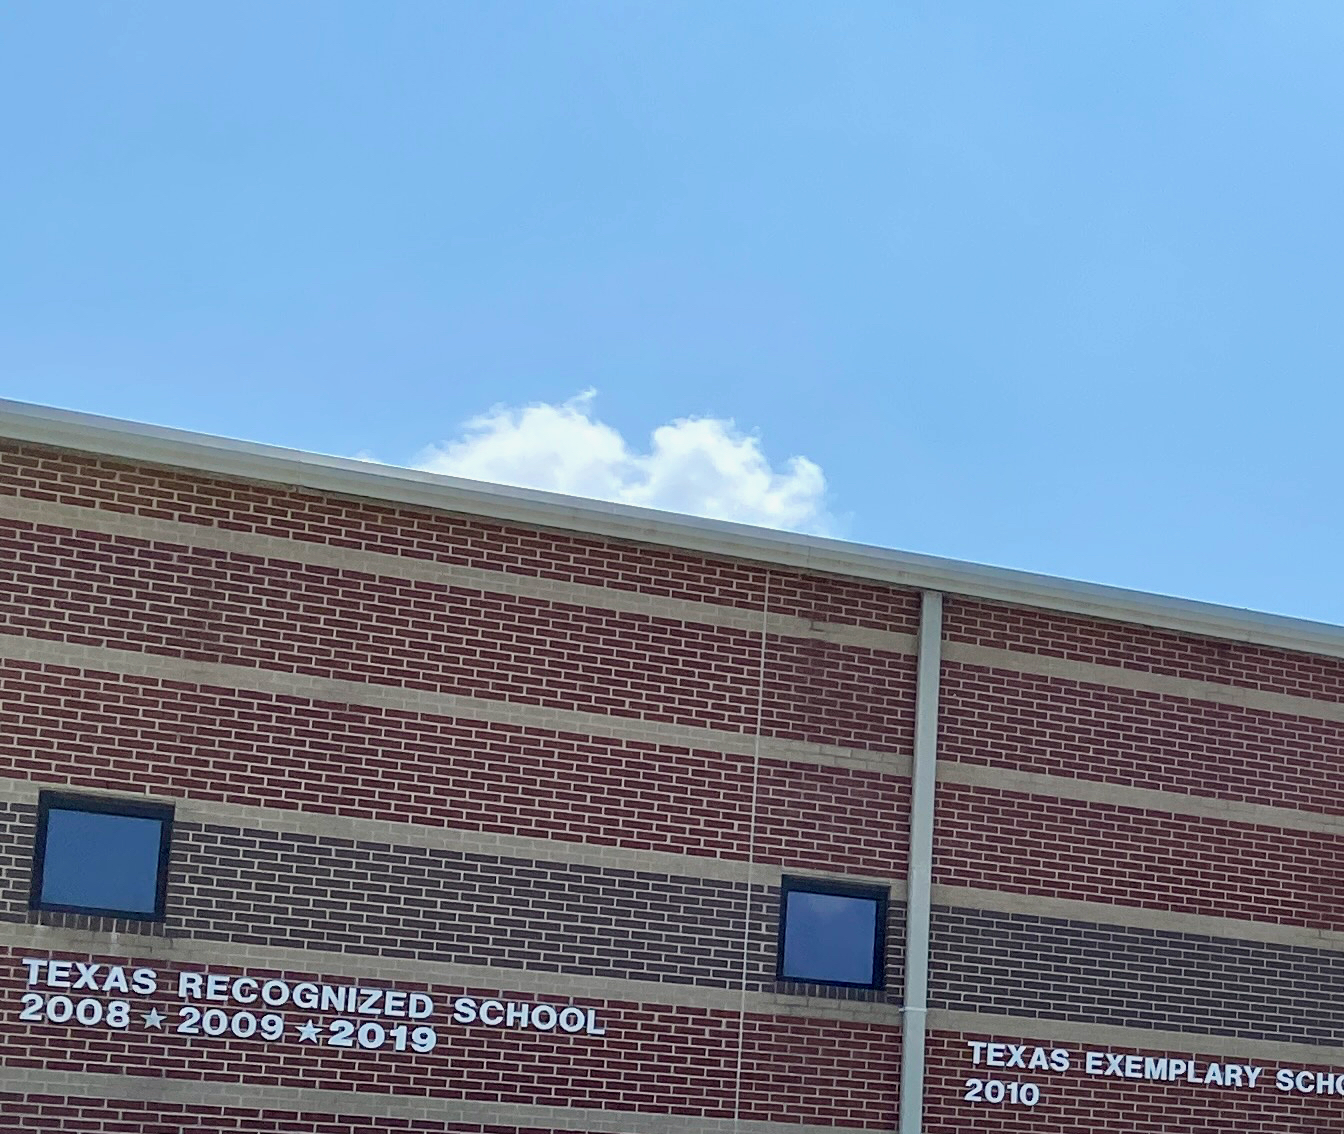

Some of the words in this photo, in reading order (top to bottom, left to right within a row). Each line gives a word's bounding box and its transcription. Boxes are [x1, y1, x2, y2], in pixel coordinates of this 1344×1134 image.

[19, 993, 131, 1029] 2008
[177, 1006, 284, 1041] 2009
[328, 1020, 437, 1053] 2019
[22, 957, 157, 995] TEXAS
[178, 971, 433, 1020] RECOGNIZED
[453, 998, 606, 1036] SCHOOL
[964, 1078, 1040, 1106] 2010
[967, 1041, 1070, 1073] TEXAS
[1085, 1051, 1261, 1089] EXEMPLARY
